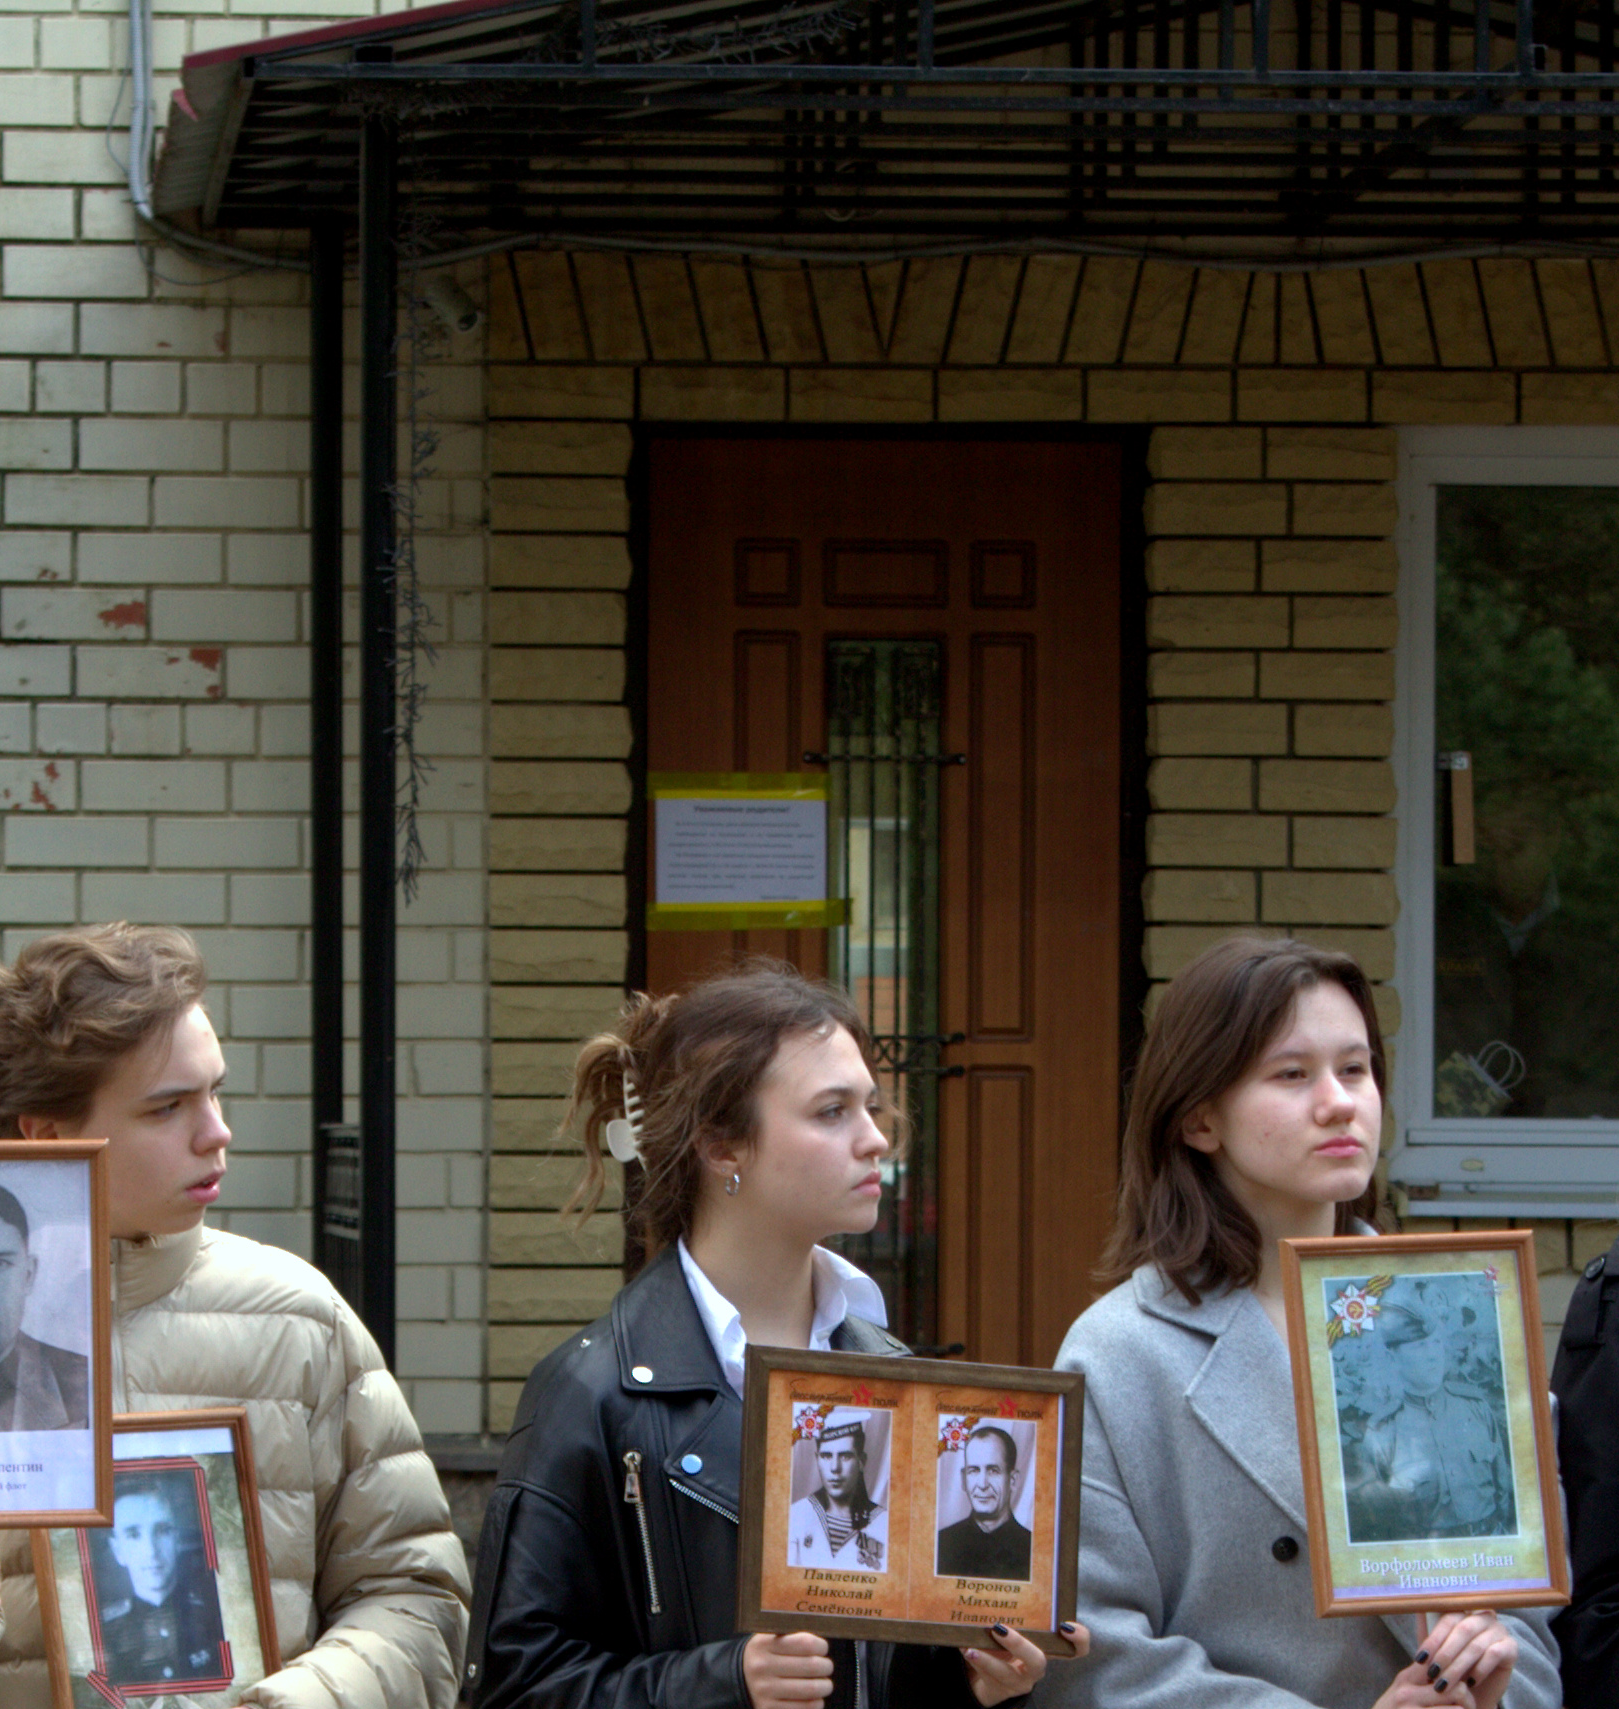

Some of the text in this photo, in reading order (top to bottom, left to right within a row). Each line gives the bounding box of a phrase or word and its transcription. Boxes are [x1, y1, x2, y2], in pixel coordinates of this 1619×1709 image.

[1360, 1552, 1515, 1577] Ворфоломеев Иван
[803, 1568, 878, 1584] Павленко
[1399, 1574, 1479, 1589] Иванович
[805, 1584, 874, 1601] Николай
[955, 1578, 1022, 1595] Воронов
[795, 1600, 883, 1618] Семёнович
[957, 1594, 1019, 1610] Михаил
[950, 1610, 1025, 1627] Иванович
